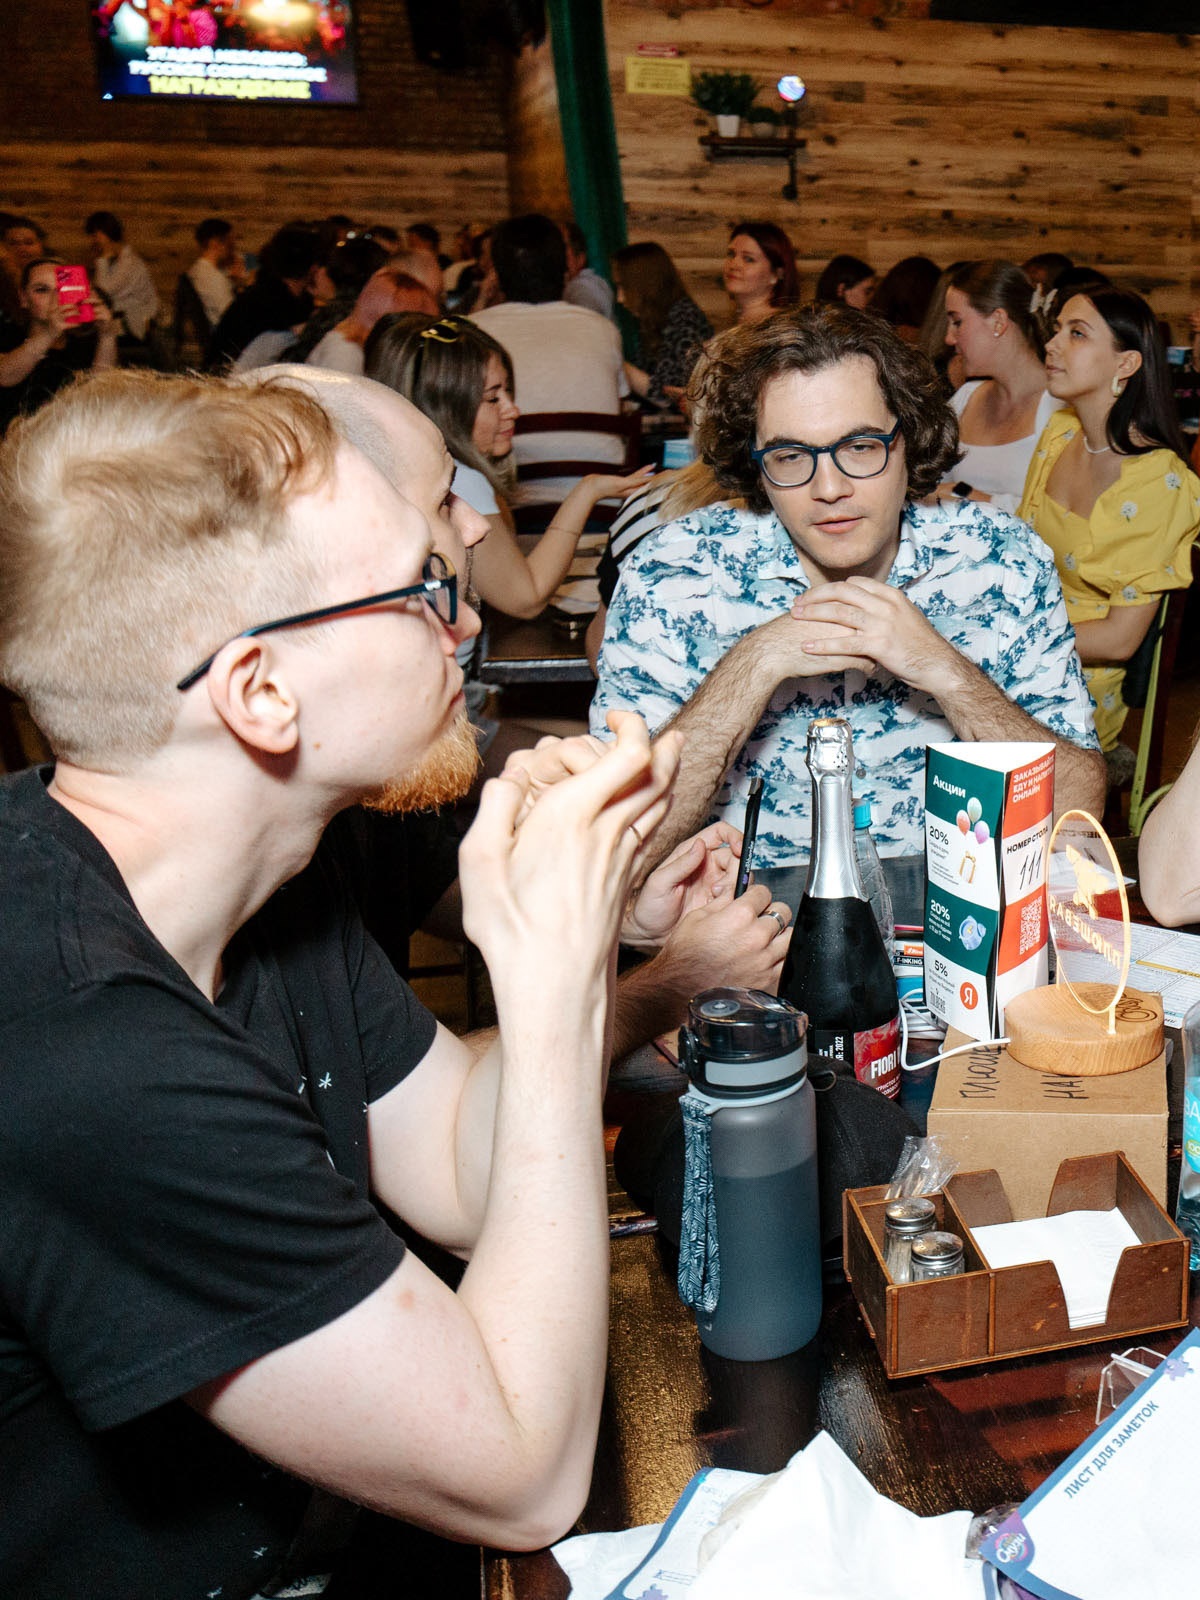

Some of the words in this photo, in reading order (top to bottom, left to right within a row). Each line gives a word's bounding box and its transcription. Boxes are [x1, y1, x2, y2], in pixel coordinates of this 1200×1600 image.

[933, 775, 966, 798] Акции
[1013, 784, 1040, 803] ОНЛАЙН
[929, 825, 949, 845] 20%
[1006, 839, 1031, 855] НОМЕР
[1032, 825, 1048, 843] СТОЛА
[931, 899, 951, 921] 20%
[934, 960, 948, 977] 5%
[835, 1036, 844, 1051] 2022
[870, 1053, 897, 1080] FIORI
[959, 1045, 1002, 1099] ПЛЮШЕ
[1041, 1075, 1089, 1100] НА
[1064, 1466, 1095, 1498] ЛИСТ
[1091, 1445, 1116, 1471] ДЛЯ
[1112, 1400, 1159, 1447] ЗАМЕТОК
